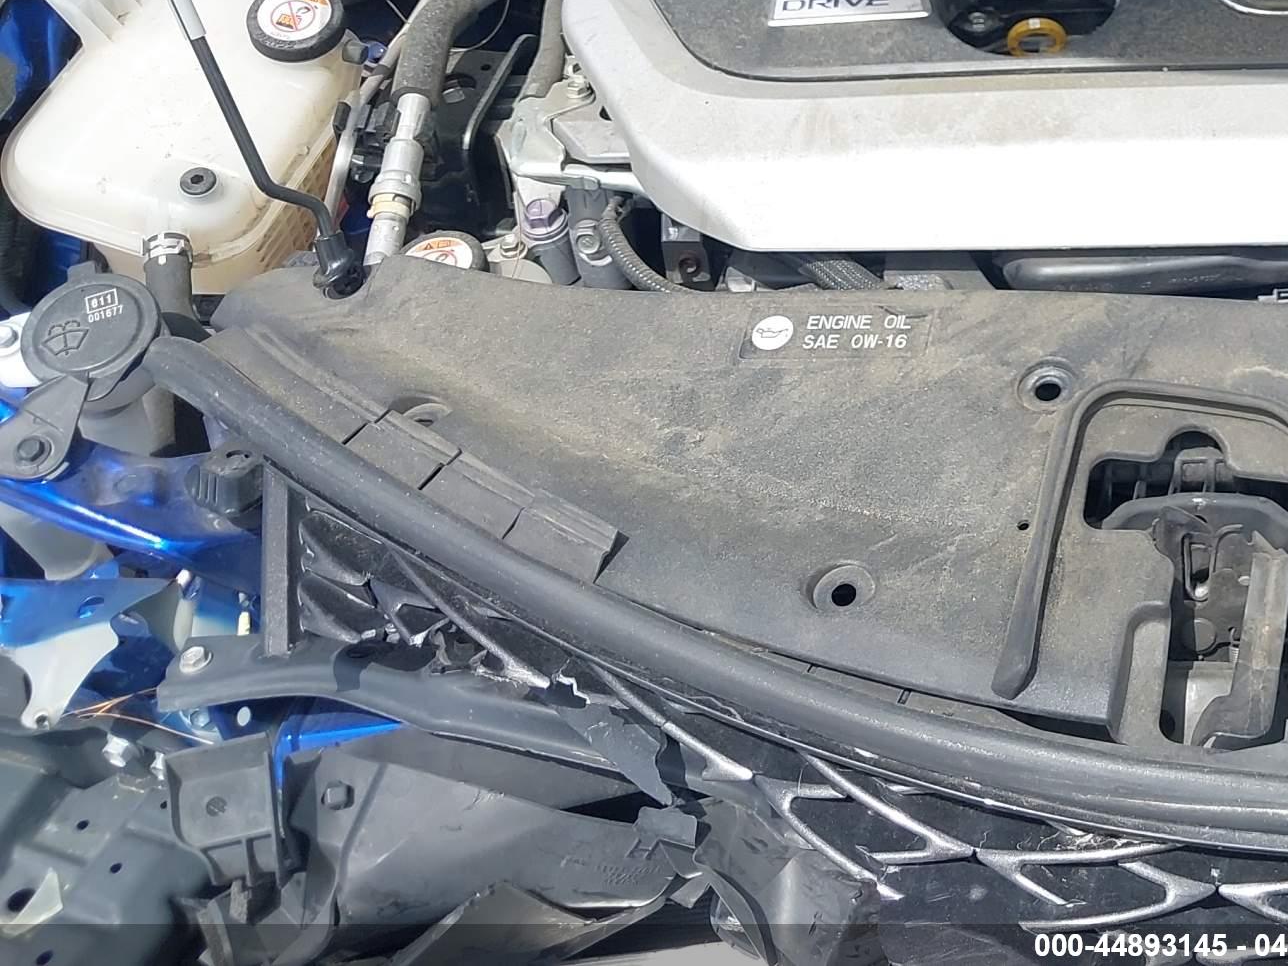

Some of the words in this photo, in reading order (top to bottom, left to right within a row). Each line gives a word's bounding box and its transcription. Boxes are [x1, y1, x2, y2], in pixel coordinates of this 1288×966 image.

[806, 314, 873, 330] ENGINE
[883, 314, 912, 330] OIL
[802, 333, 840, 349] SAE
[850, 333, 908, 349] 0W-16
